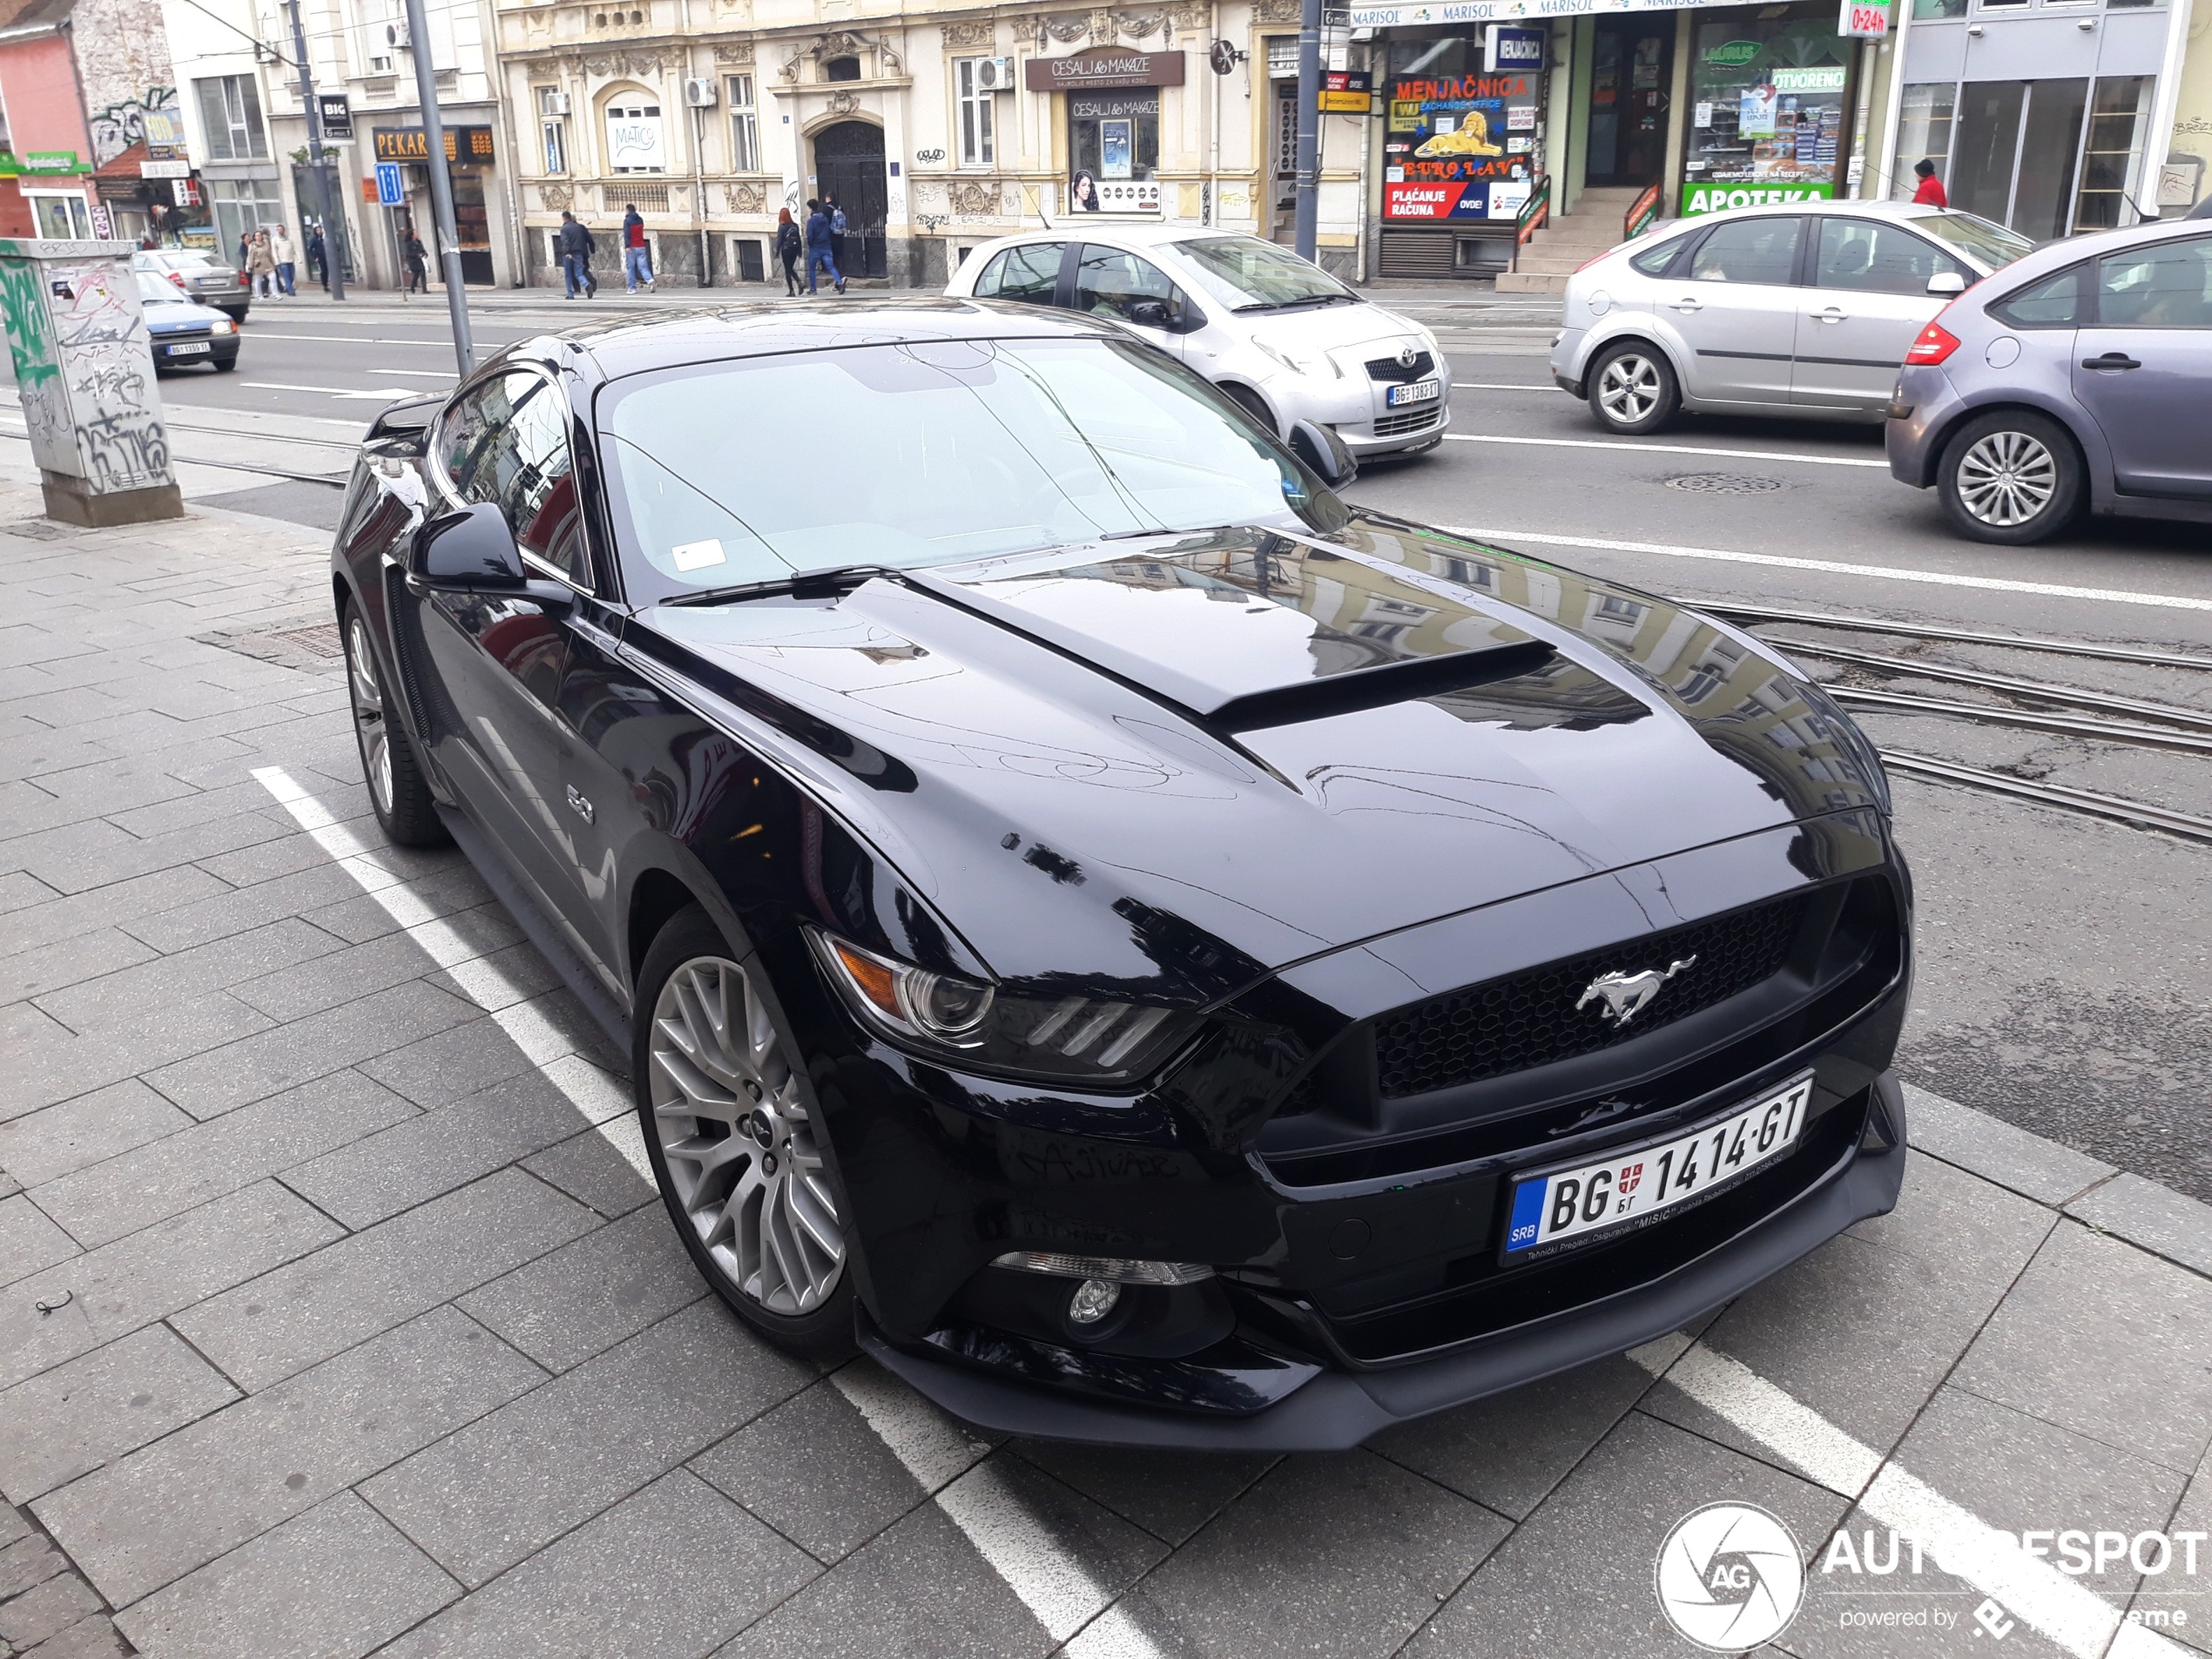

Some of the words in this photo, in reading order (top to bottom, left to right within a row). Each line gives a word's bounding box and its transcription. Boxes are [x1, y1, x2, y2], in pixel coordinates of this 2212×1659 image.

[1442, 4, 1495, 19] MARISOL
[1539, 0, 1594, 13] MARISOL
[1352, 10, 1400, 24] MARISOL
[1852, 9, 1885, 31] 0-24h
[1702, 46, 1754, 61] LAURUS
[1052, 60, 1094, 77] ČEŠALJ
[1109, 57, 1151, 73] MAKAZE
[1397, 74, 1527, 100] MENJAČNICA
[1773, 71, 1845, 89] OTVORENO
[324, 104, 346, 115] BIG
[1073, 103, 1110, 117] ČEŠALJ
[1123, 100, 1159, 115] MAKAZE
[1420, 99, 1466, 111] EXCHANGE
[1470, 98, 1502, 110] OFFICE
[378, 133, 428, 156] PEKAR
[616, 126, 654, 149] MATICO
[1392, 187, 1446, 202] PLAĆANJE
[1392, 200, 1434, 215] RAČUNA
[1460, 199, 1482, 209] OVDE!
[1395, 388, 1406, 402] BG
[1548, 1170, 1612, 1233] BG
[1511, 1224, 1535, 1243] SRB
[1527, 1244, 1557, 1260] Tehnički
[1560, 1237, 1588, 1252] Pregled
[1592, 1225, 1631, 1242] Osiguranje
